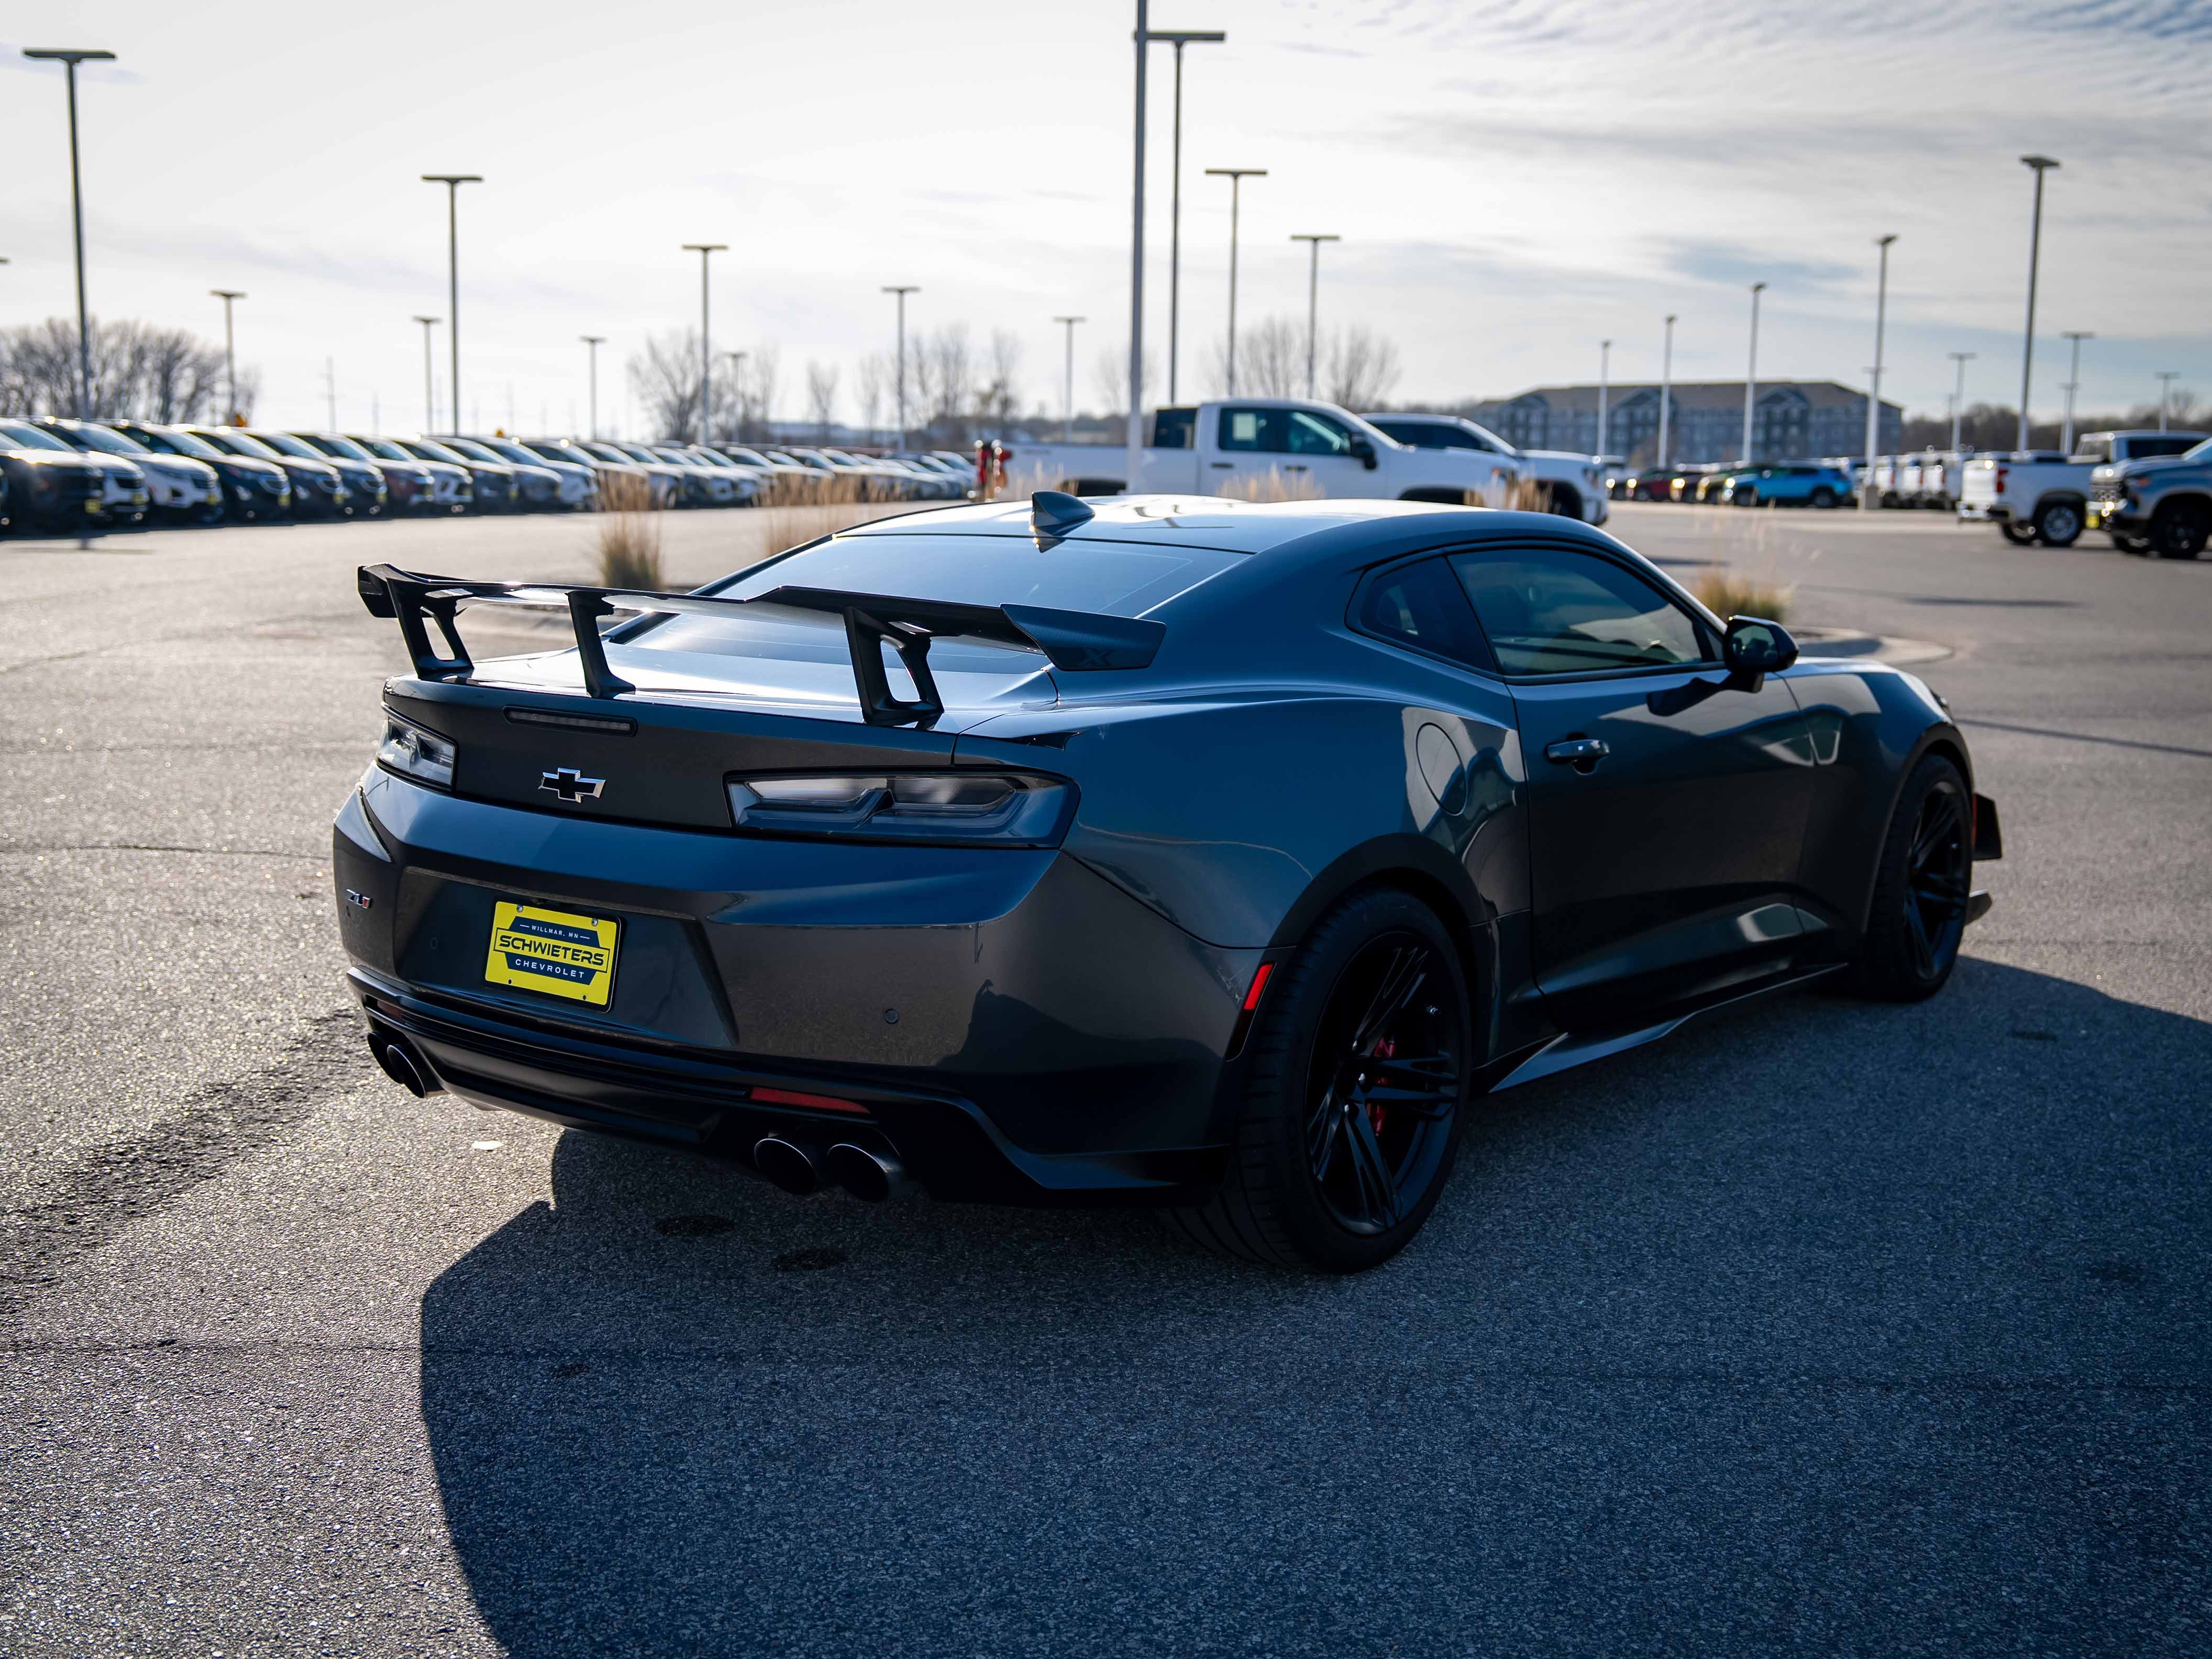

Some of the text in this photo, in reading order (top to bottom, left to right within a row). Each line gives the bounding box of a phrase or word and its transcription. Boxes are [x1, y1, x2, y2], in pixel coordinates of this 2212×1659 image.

[532, 925, 566, 936] WILLMAR,
[499, 935, 604, 966] SCHWIETERS
[515, 959, 584, 978] CHEVROLET
